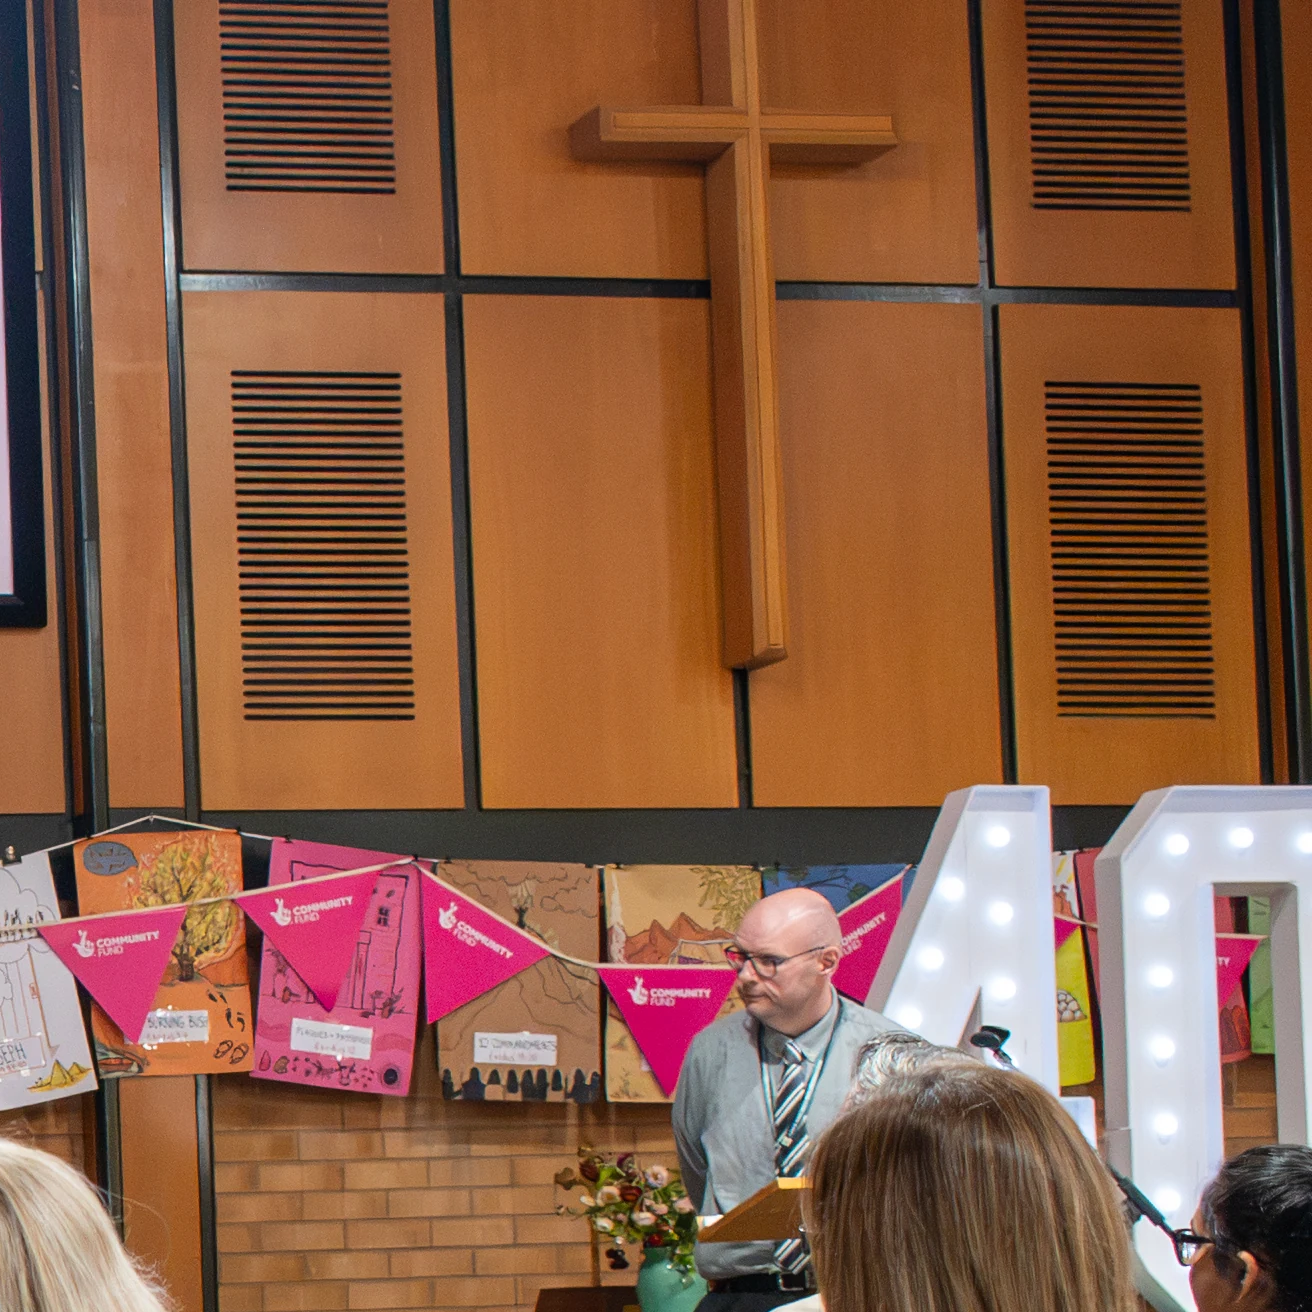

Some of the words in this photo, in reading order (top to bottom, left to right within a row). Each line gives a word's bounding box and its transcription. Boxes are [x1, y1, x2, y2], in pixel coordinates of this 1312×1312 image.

[292, 896, 353, 916] COMMUNITY
[294, 912, 320, 925] FUND
[841, 911, 886, 946] OMMUNITY
[96, 930, 160, 948] COMMUNITY
[456, 921, 514, 959] COMMUNITY
[97, 945, 124, 958] FUND
[649, 988, 712, 999] COMMUNITY
[649, 997, 676, 1007] FUND
